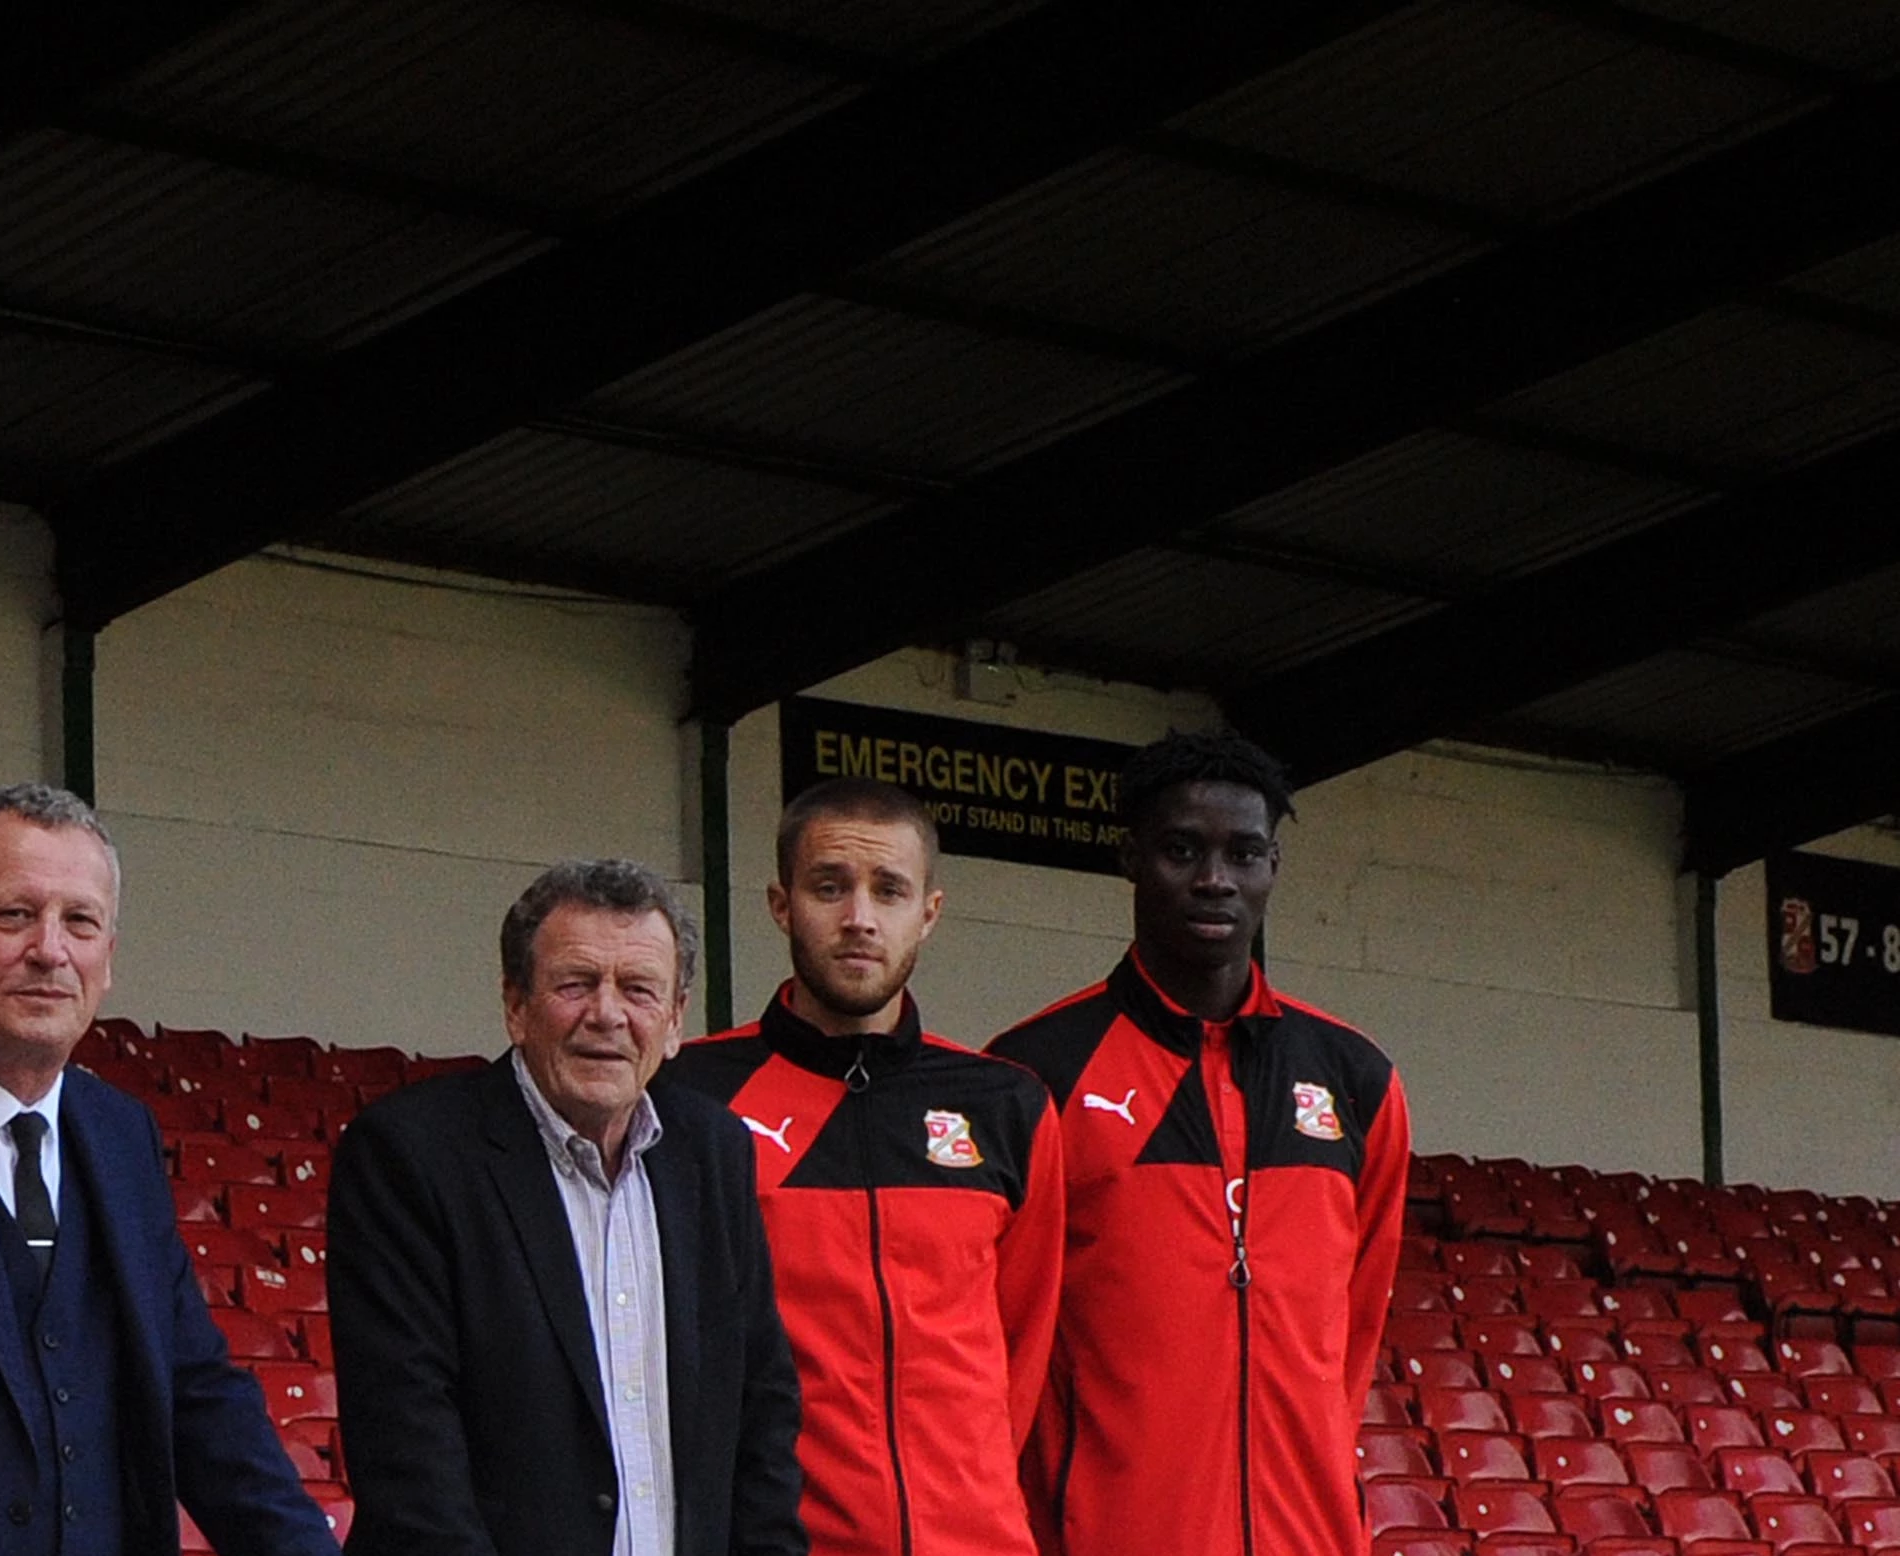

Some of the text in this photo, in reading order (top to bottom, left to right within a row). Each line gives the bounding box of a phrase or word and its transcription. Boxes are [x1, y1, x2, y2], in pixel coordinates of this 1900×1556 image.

[815, 730, 1123, 815] EMERGENCY EXI
[966, 805, 1025, 834] STAND
[1030, 815, 1048, 838] IN
[1052, 817, 1093, 844] THIS
[1820, 913, 1860, 966] 57
